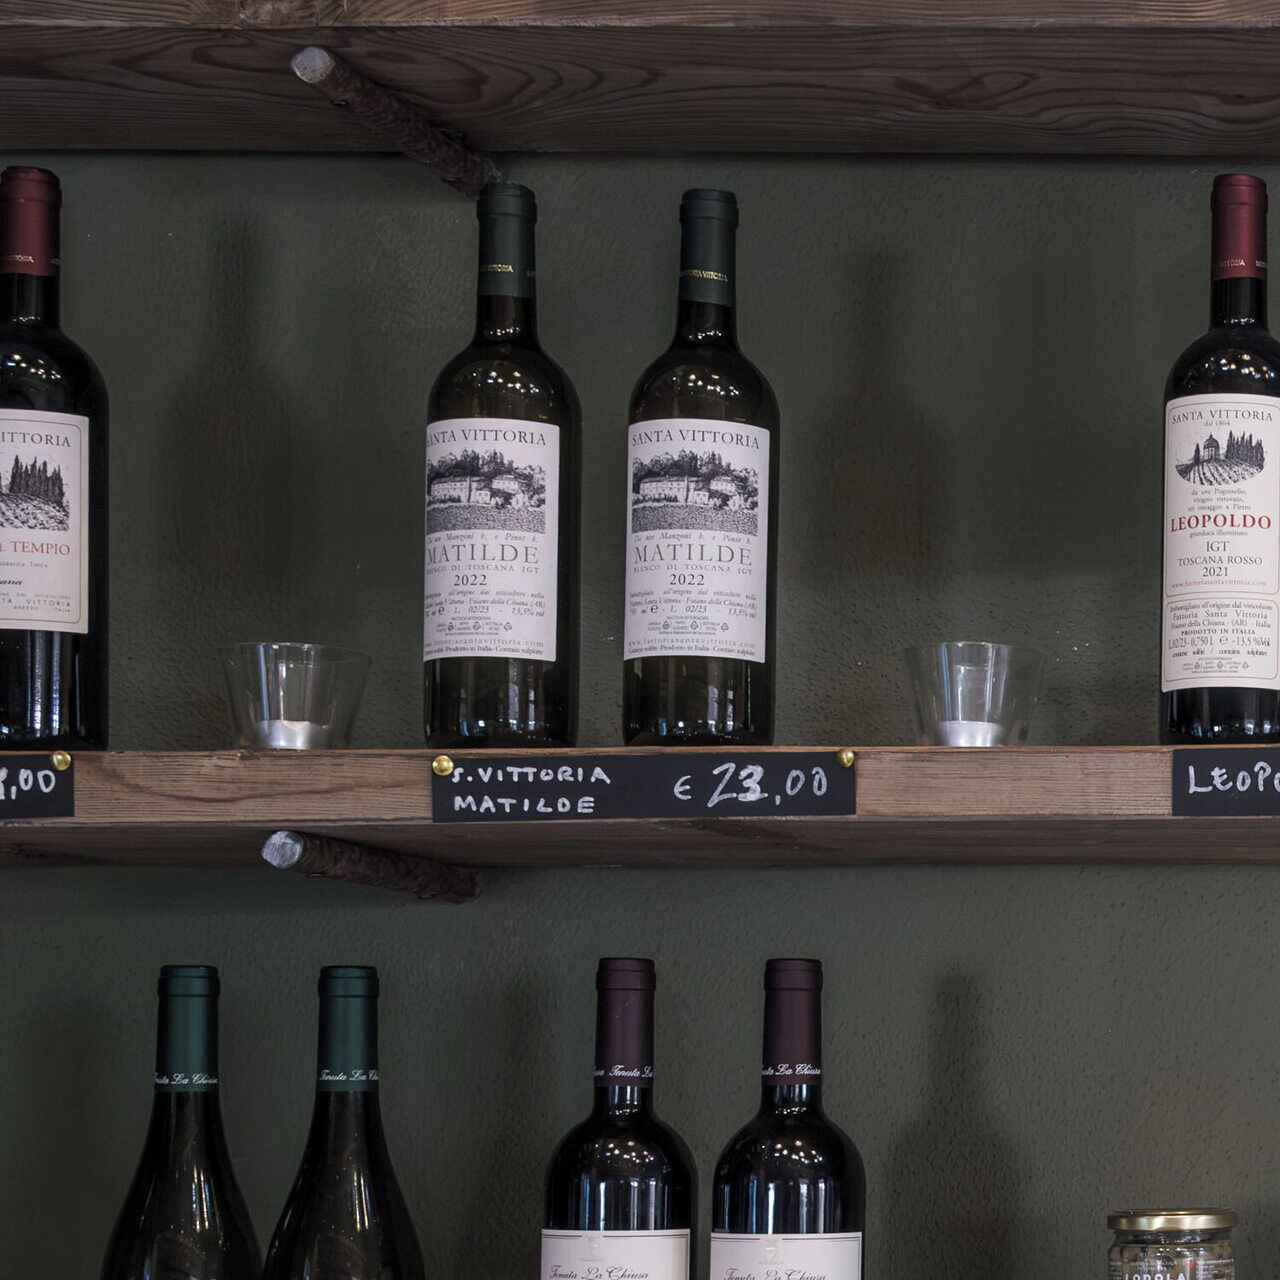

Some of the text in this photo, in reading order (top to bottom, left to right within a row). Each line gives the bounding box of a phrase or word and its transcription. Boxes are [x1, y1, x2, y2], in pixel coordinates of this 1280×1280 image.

[1172, 409, 1273, 425] SANTA VITTORIA
[461, 429, 547, 446] VITTORIA
[632, 429, 760, 450] SANTA VITTORIA
[1170, 513, 1272, 533] LEOPOLDO
[11, 541, 71, 556] TEMPIO
[427, 543, 539, 565] MATILDE
[1206, 541, 1230, 552] IGT
[634, 543, 752, 567] MATILDE
[1178, 556, 1263, 567] TOSCANA ROSSO
[453, 573, 488, 587] 2022
[669, 573, 705, 587] 2022
[454, 796, 596, 814] MATILDE
